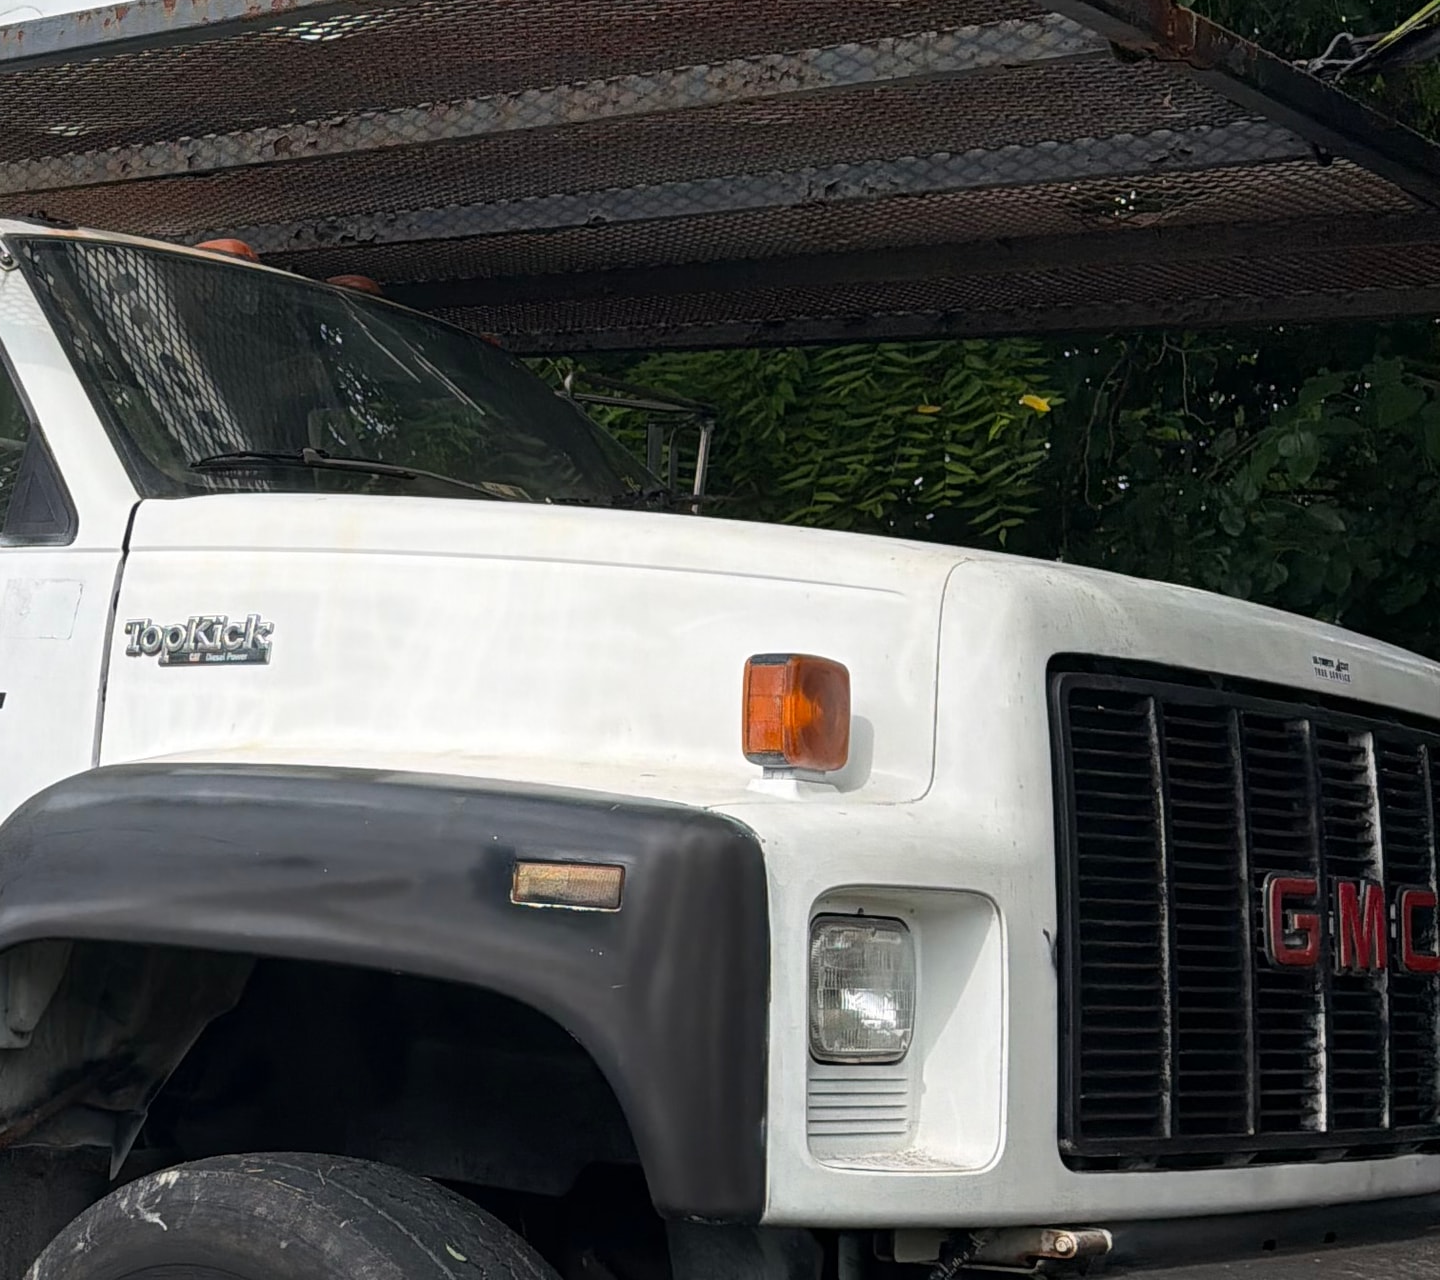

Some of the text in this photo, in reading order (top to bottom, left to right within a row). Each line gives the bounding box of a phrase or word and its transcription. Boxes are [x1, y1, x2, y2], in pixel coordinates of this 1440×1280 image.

[125, 614, 275, 664] TopKick
[205, 652, 226, 662] Diesel
[226, 652, 248, 662] Power
[1264, 872, 1440, 973] GMC
